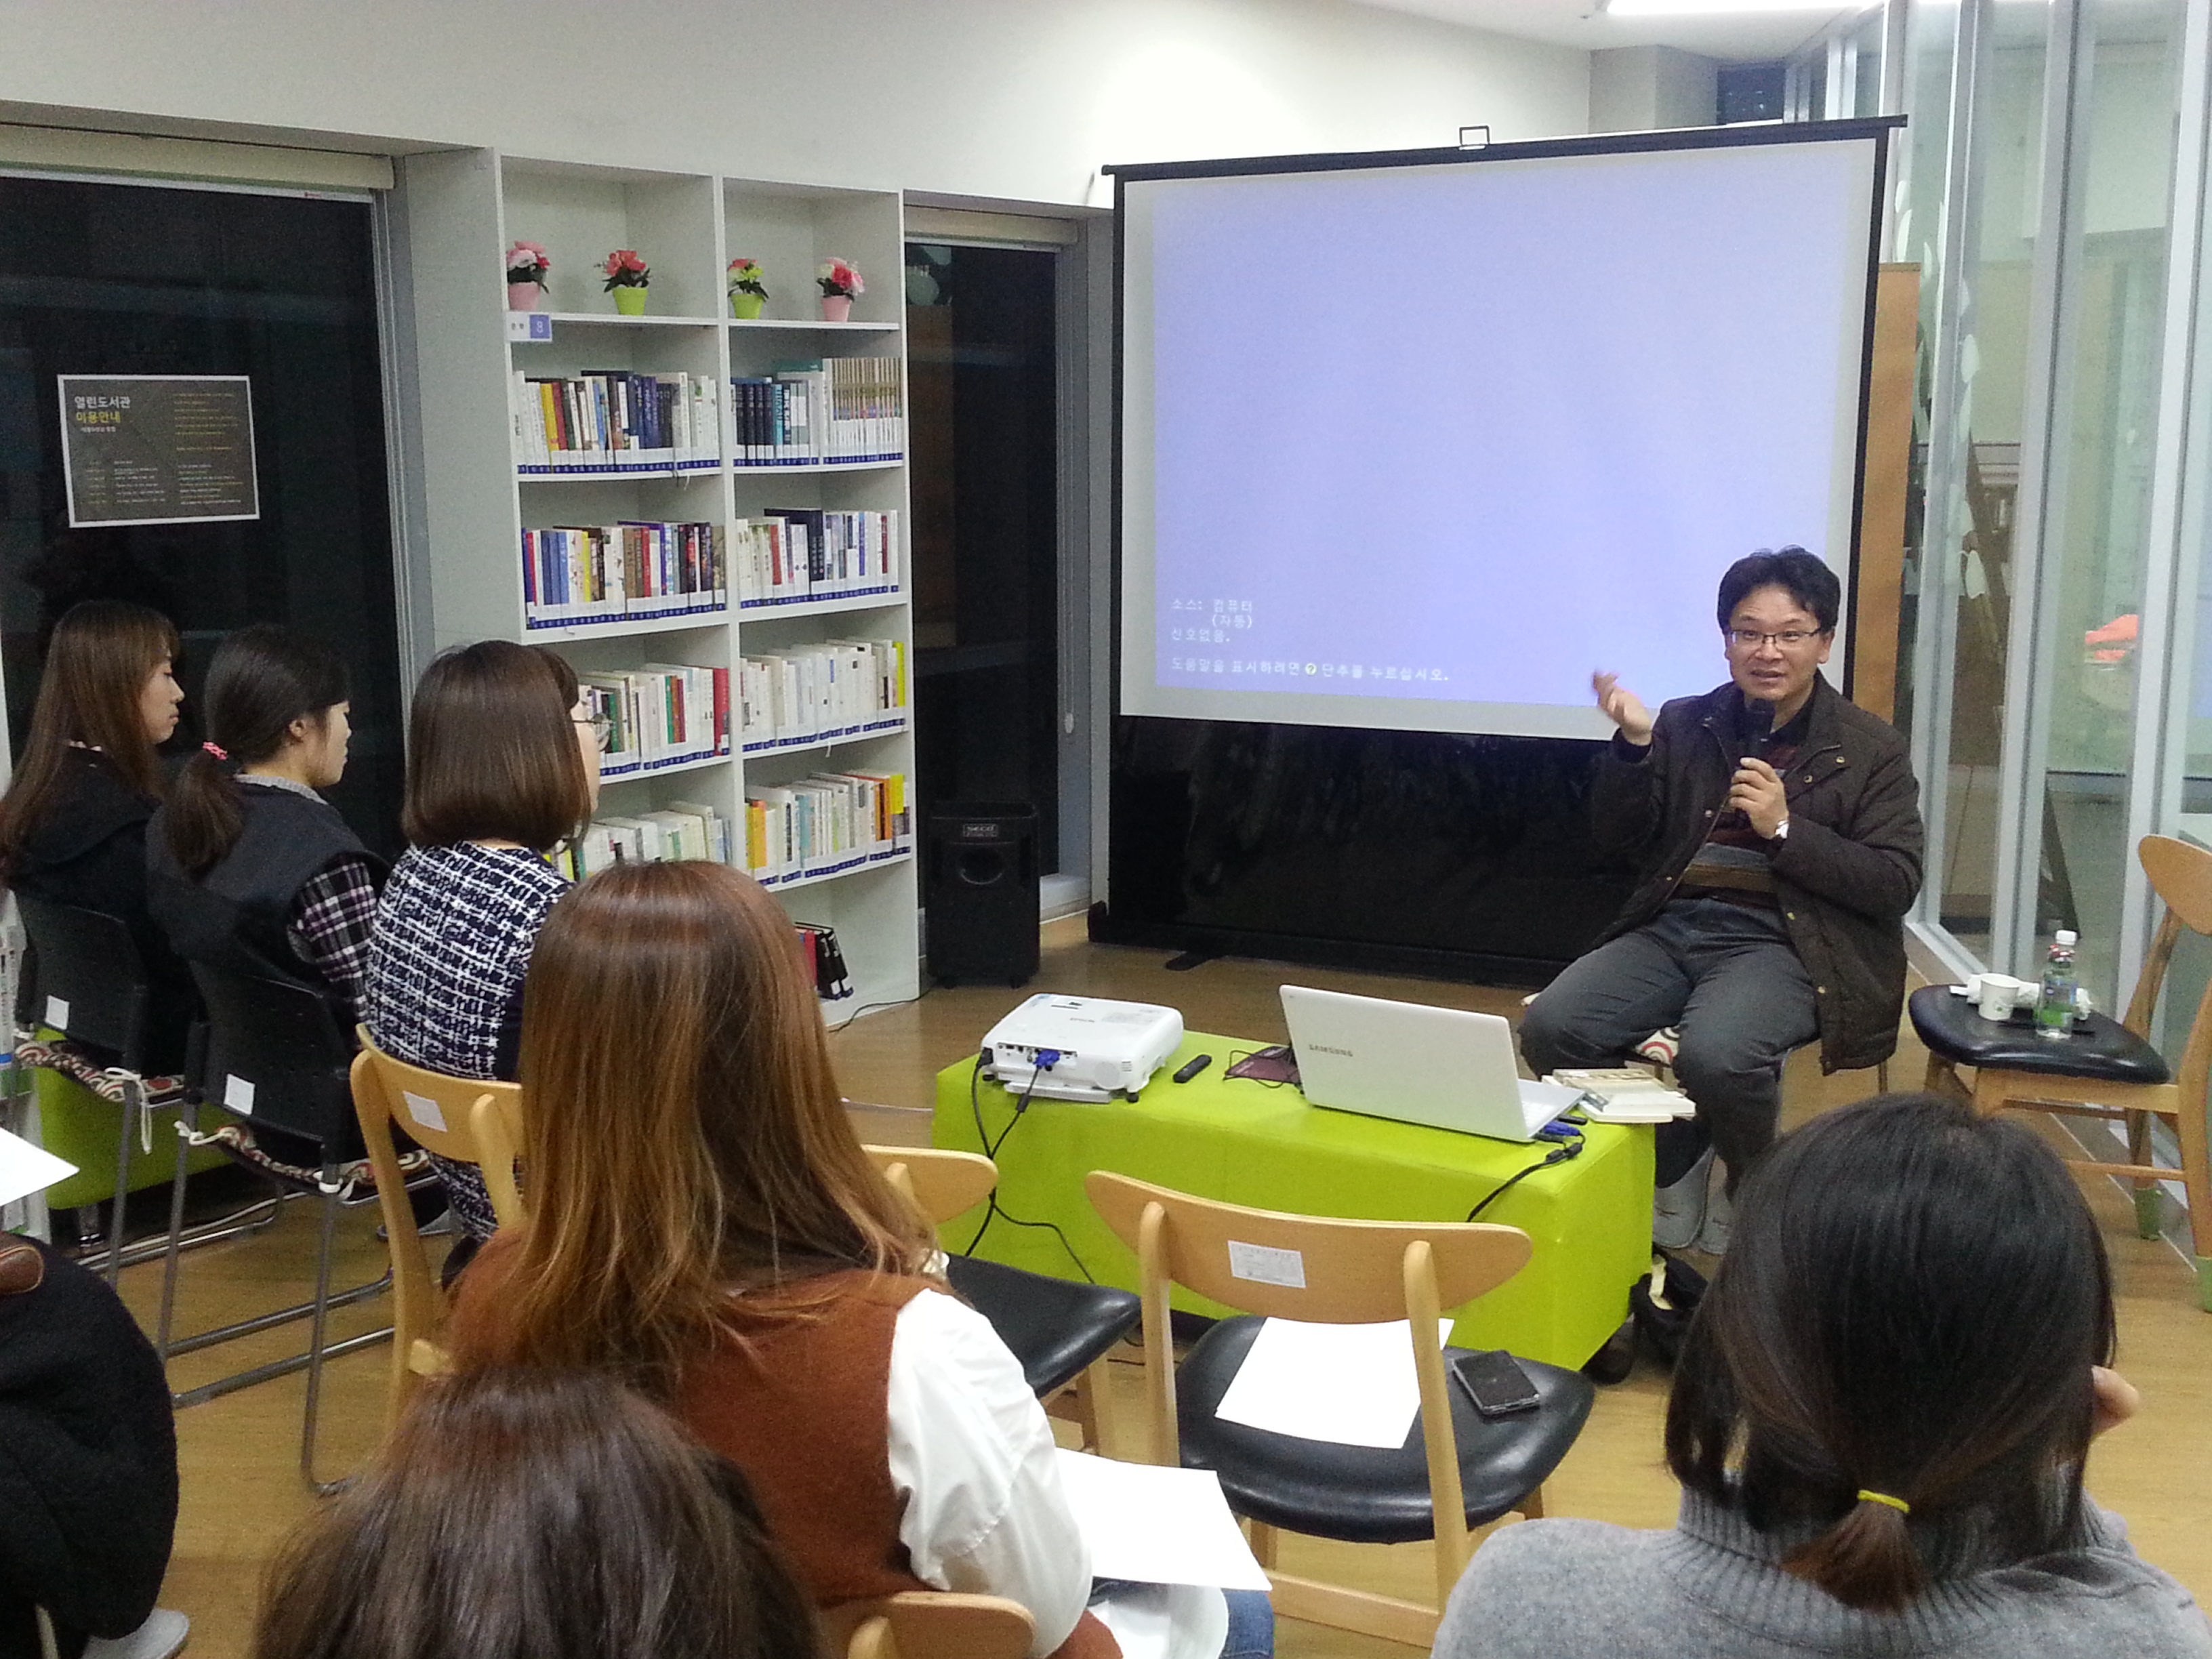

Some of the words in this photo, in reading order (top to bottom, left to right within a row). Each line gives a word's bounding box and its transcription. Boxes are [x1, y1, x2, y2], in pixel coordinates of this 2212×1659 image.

[536, 320, 544, 334] 8
[74, 396, 131, 409] 열린도서관
[76, 411, 121, 424] 이용안내
[1172, 598, 1203, 610] 소스:
[1214, 599, 1252, 613] 컴퓨터
[1212, 614, 1252, 629] (자동)
[1172, 657, 1224, 674] 도움말을
[1231, 660, 1300, 676] 표시하려면
[1322, 663, 1363, 678] 단추를
[1370, 666, 1449, 682] 누르십시오.
